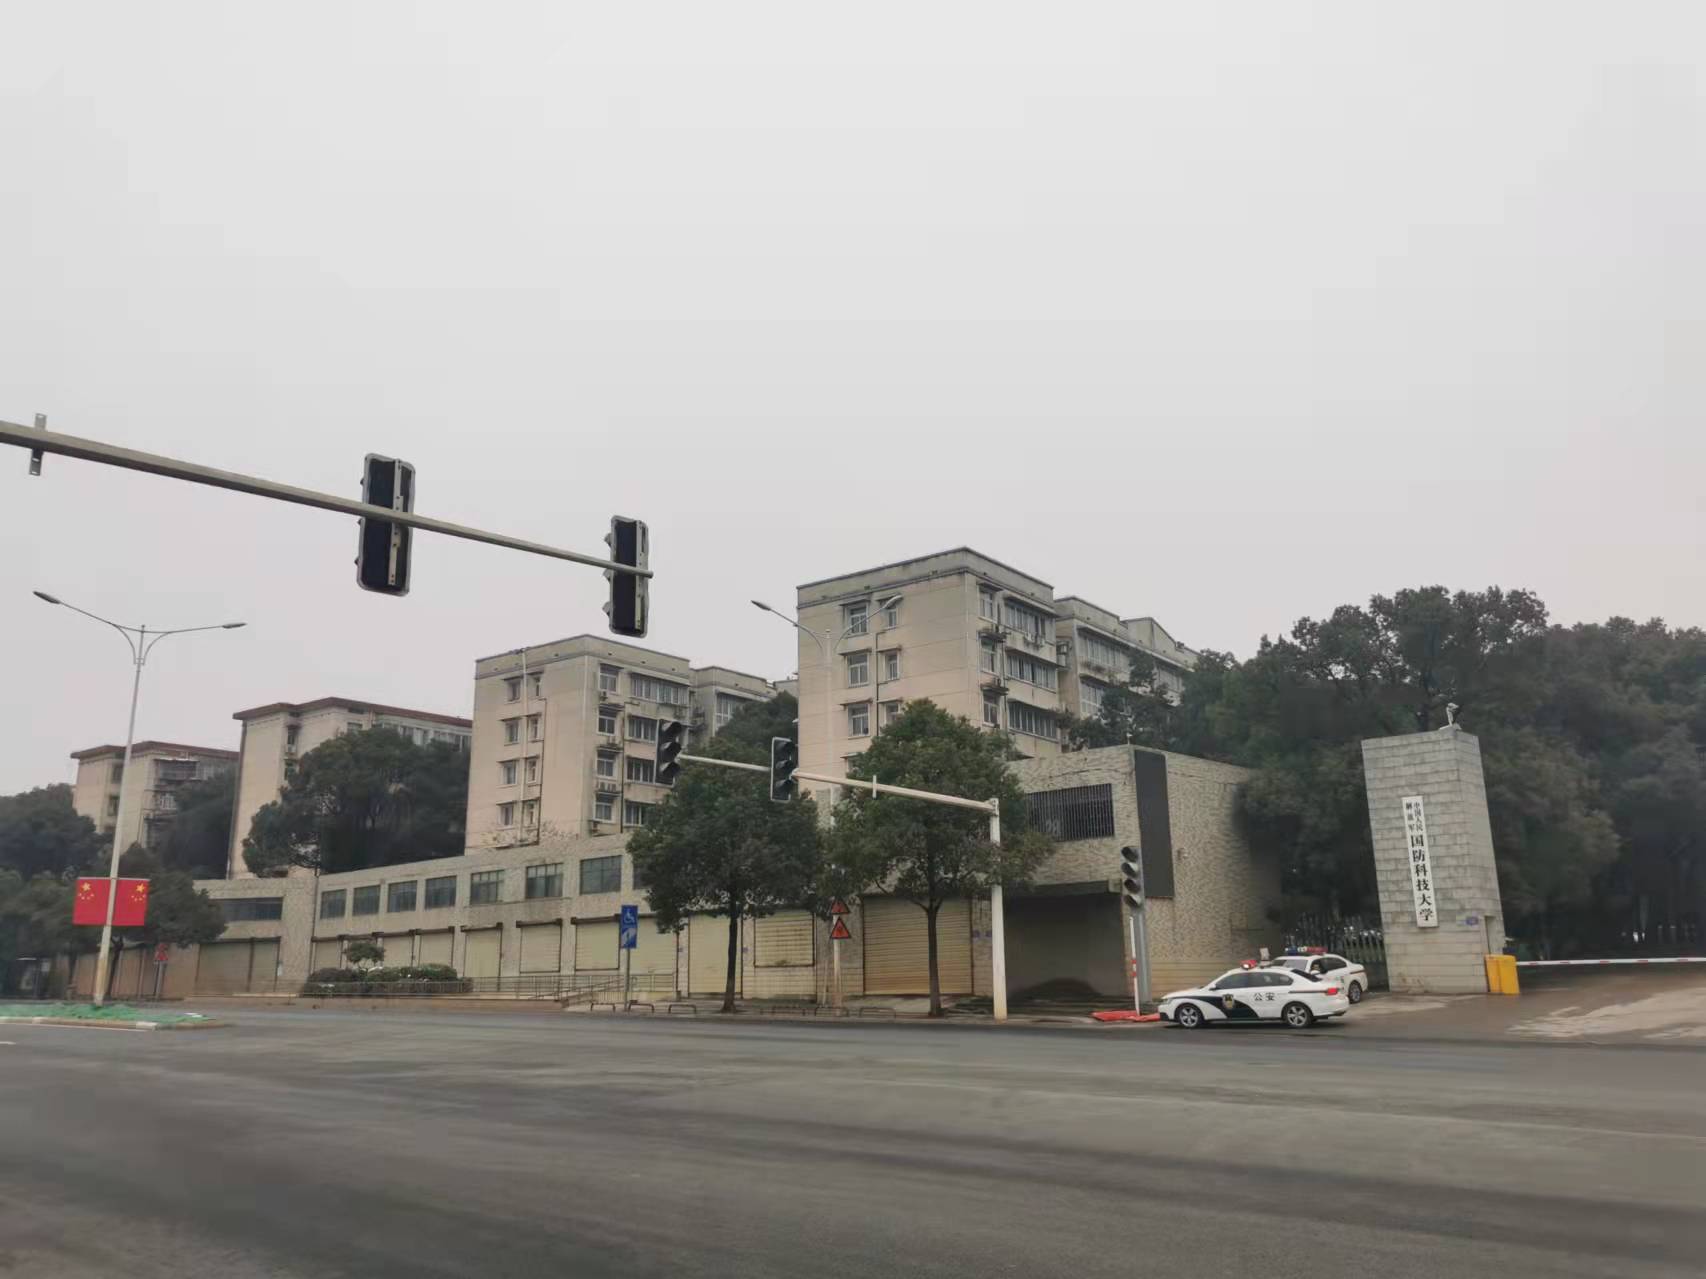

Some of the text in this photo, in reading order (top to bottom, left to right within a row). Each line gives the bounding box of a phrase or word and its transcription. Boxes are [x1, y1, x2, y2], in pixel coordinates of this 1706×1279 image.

[1411, 834, 1434, 921] 国防科技大学
[1254, 992, 1275, 1001] 公安
